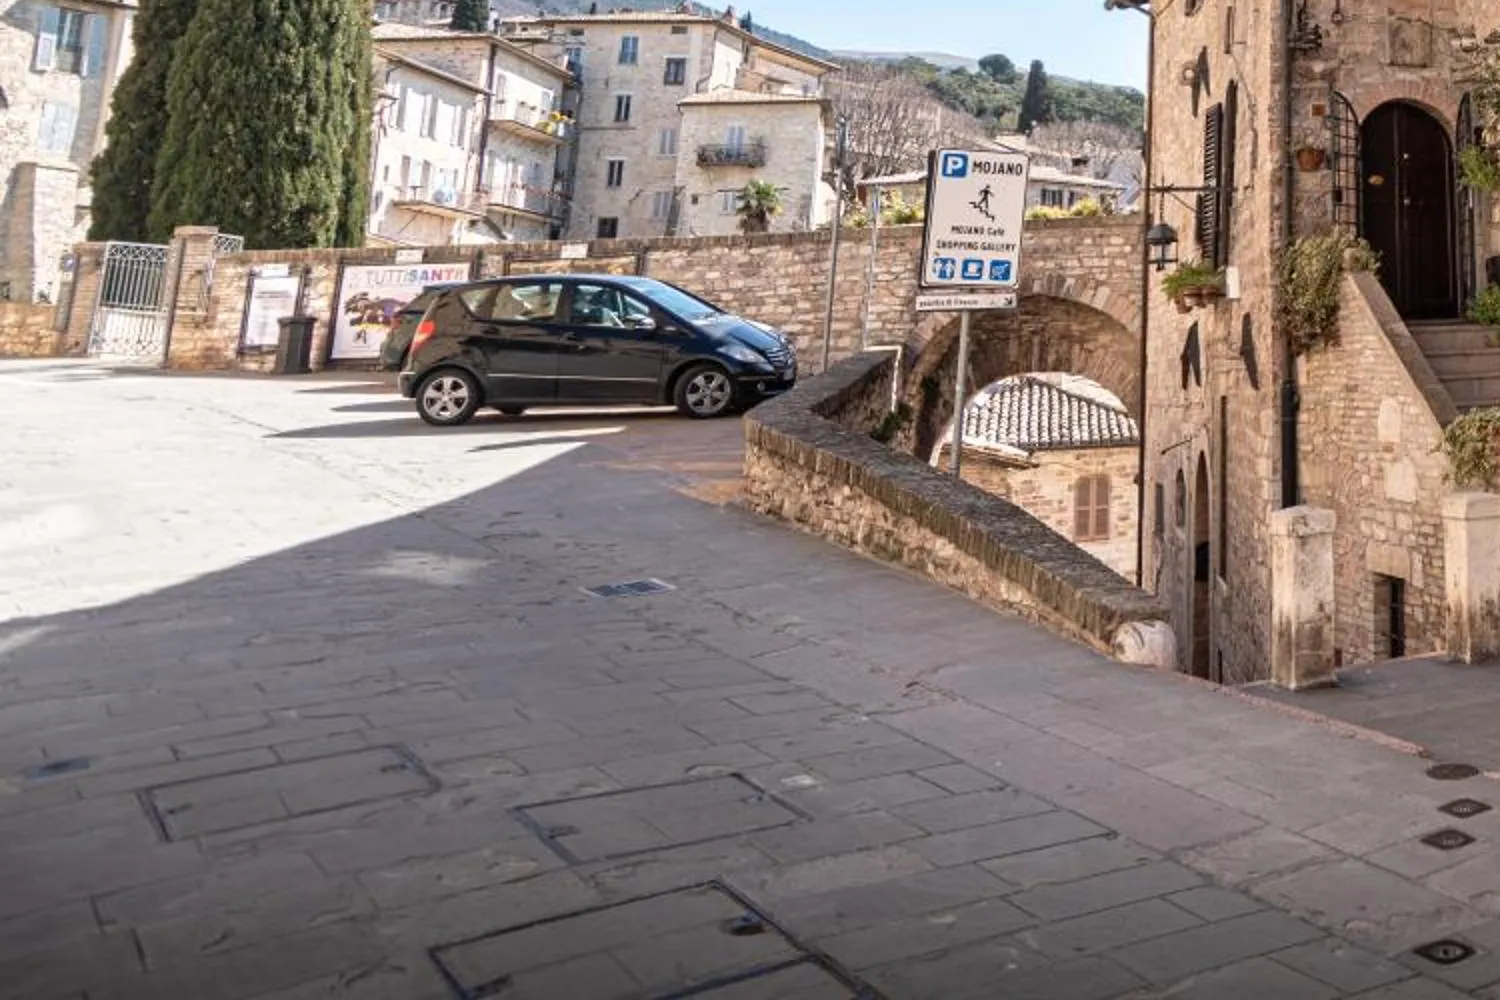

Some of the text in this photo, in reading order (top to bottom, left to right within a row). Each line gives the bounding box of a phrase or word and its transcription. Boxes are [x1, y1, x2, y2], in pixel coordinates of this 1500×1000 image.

[946, 156, 1023, 176] P MOJANO
[951, 225, 985, 236] MOJANO
[936, 239, 1017, 252] SHOPPING GALLERY
